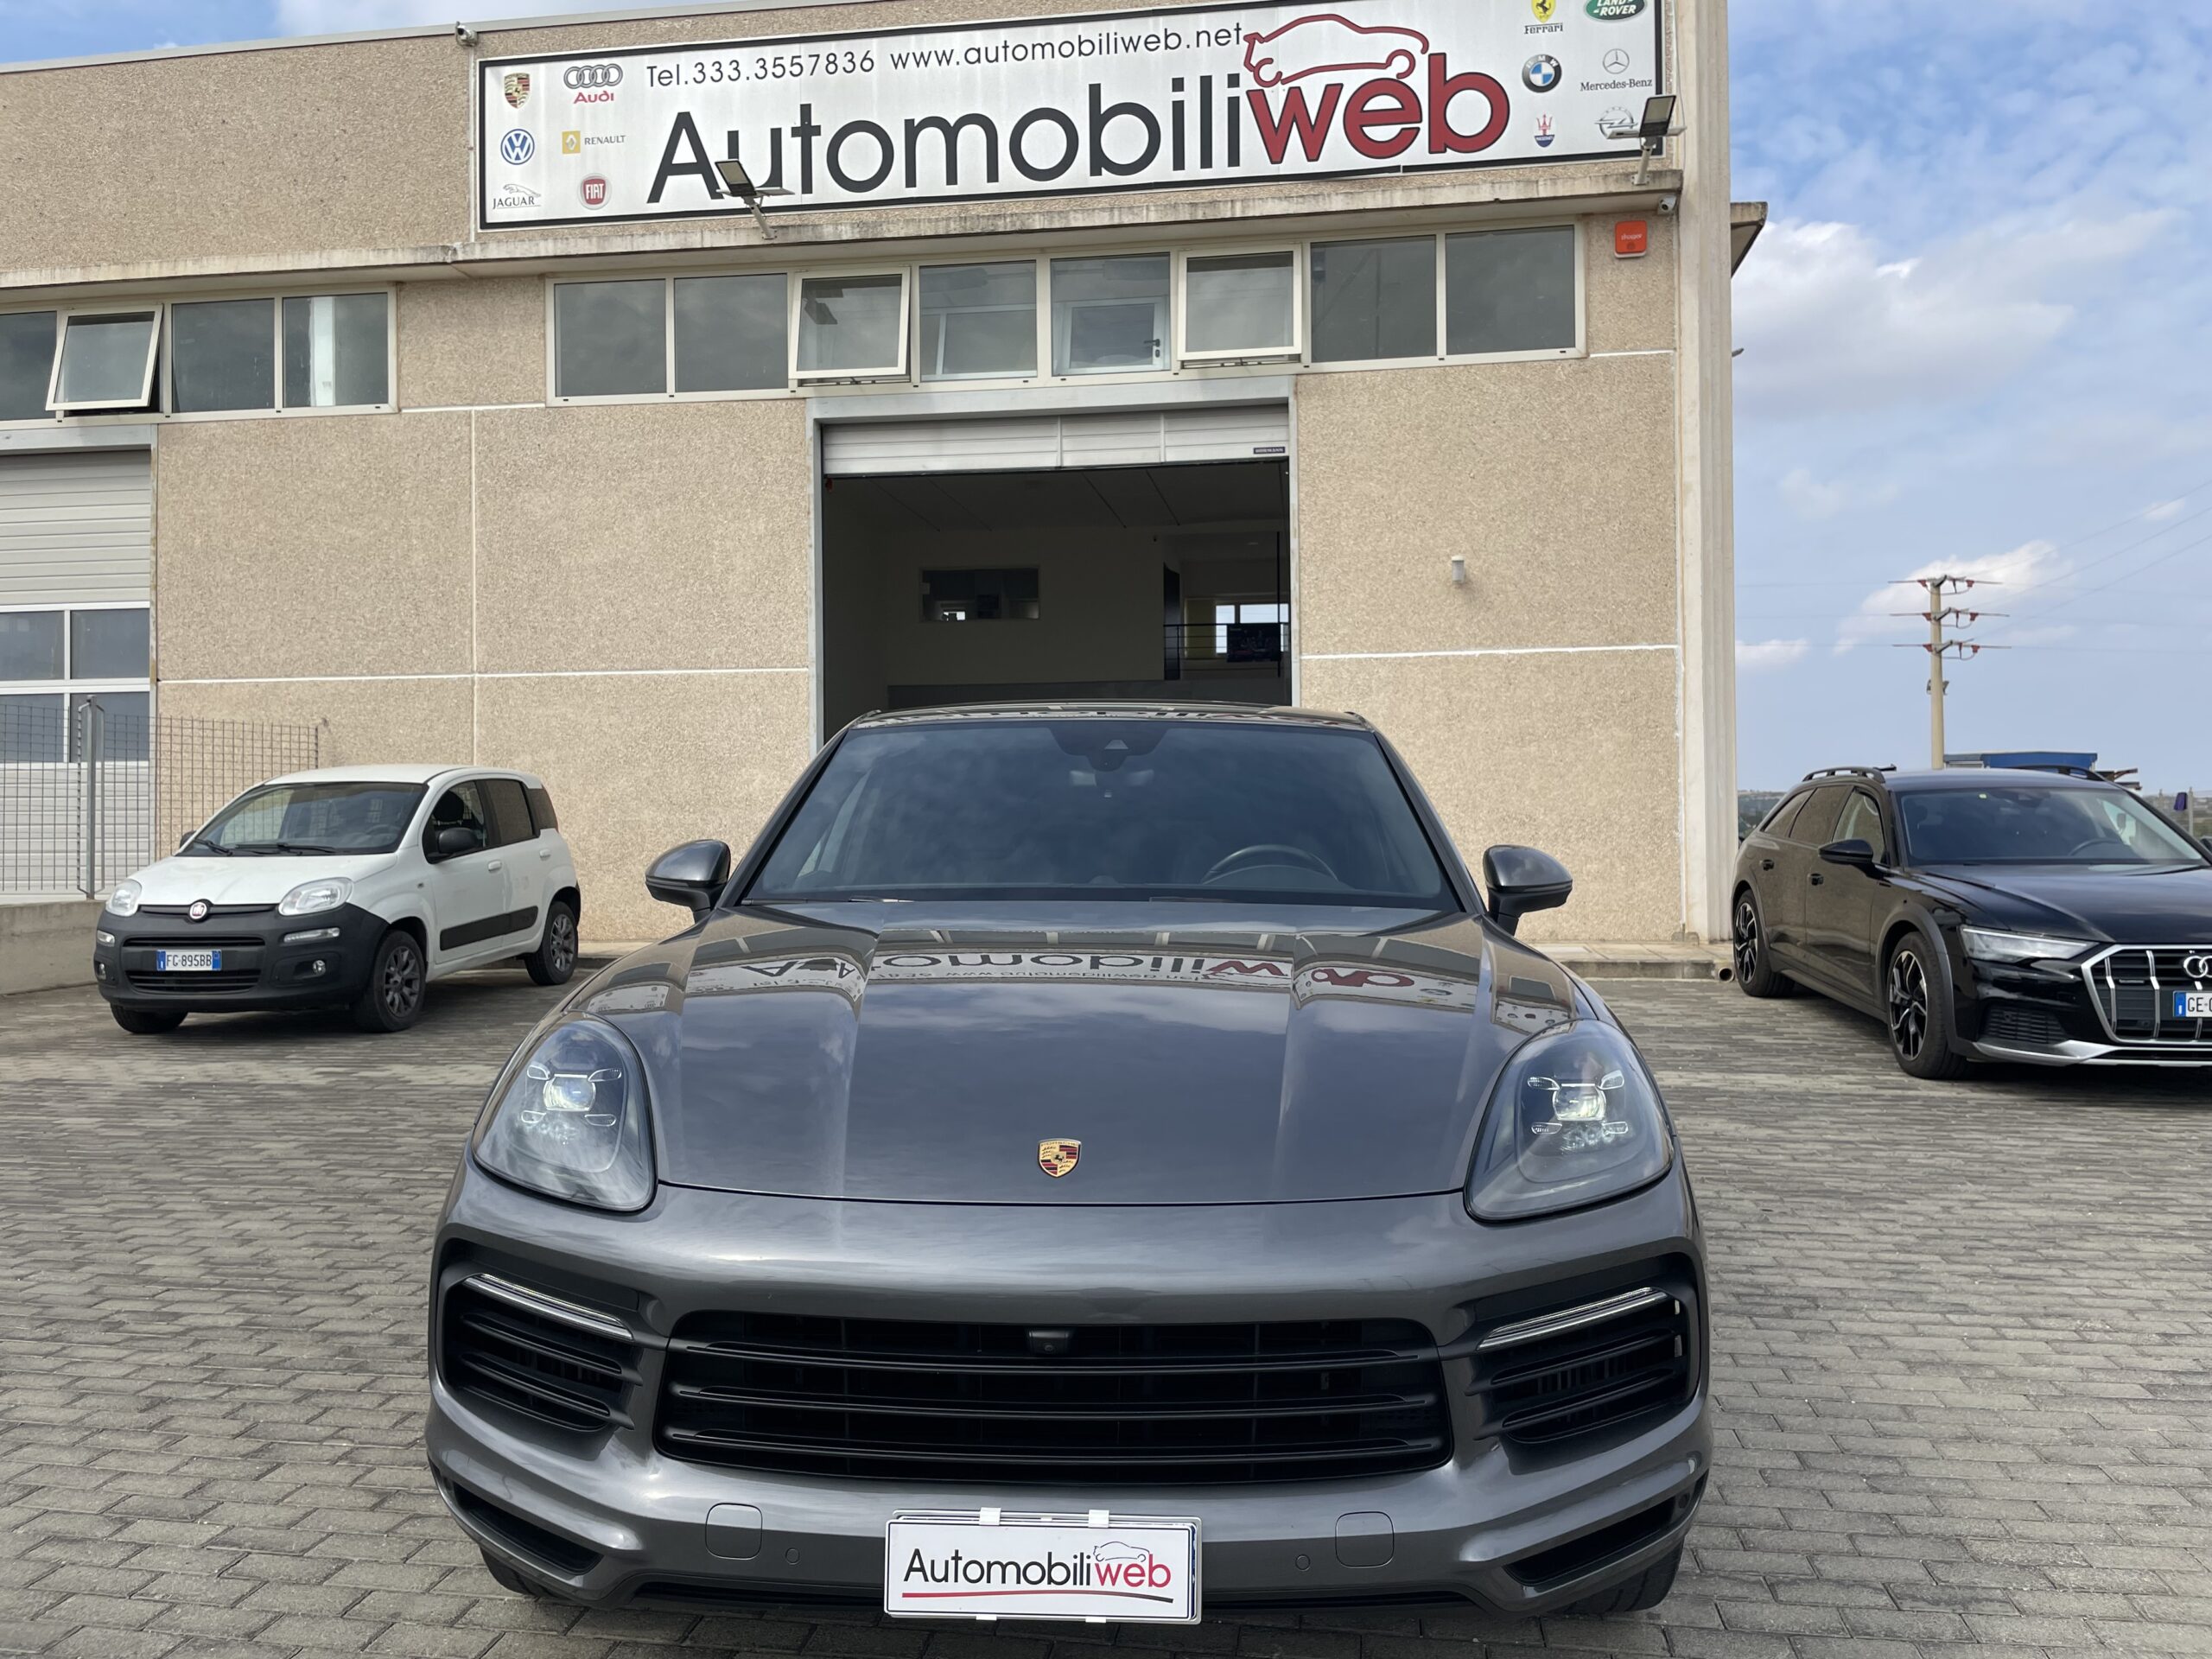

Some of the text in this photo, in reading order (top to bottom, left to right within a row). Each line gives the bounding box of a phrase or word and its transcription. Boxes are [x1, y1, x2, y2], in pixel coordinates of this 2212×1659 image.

[1524, 22, 1563, 35] Ferrari
[646, 22, 1243, 87] Tel.333.3557836 www.automobiliweb.net
[1580, 78, 1653, 92] Mercedes-Benz
[574, 90, 614, 104] Audi
[584, 135, 626, 145] RENAULT
[585, 183, 604, 200] FIAT
[493, 195, 535, 210] JAGUAR
[903, 1548, 1172, 1588] Automobiliweb
